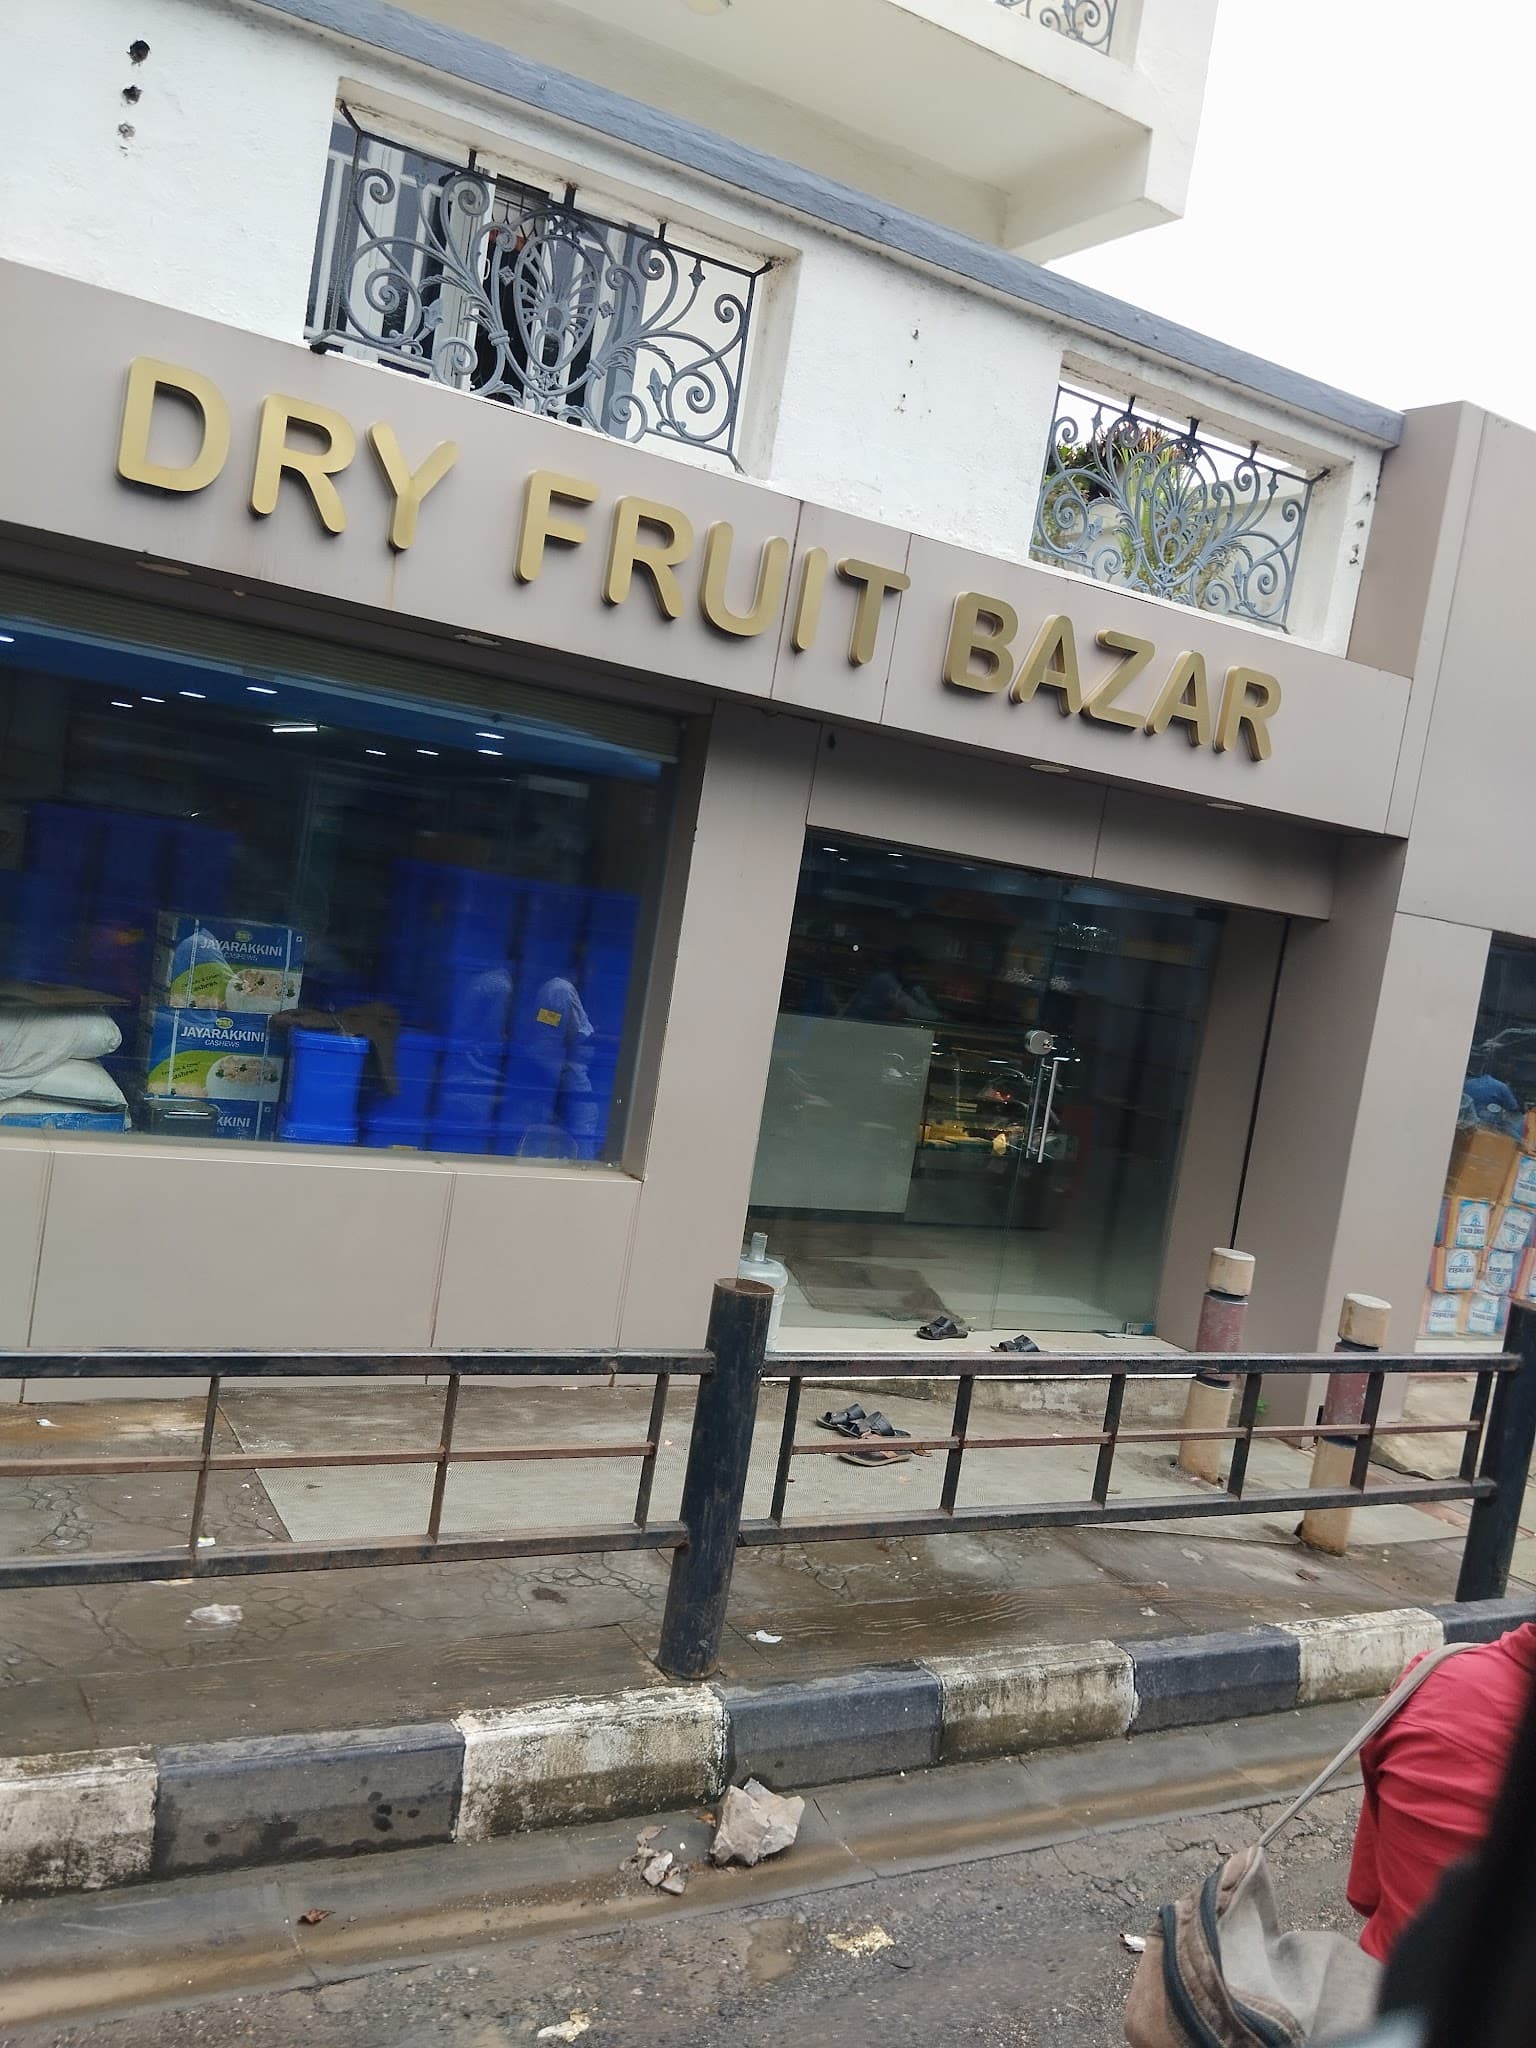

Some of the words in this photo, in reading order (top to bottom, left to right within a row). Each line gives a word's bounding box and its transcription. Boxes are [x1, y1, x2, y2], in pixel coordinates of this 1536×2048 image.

[116, 355, 460, 552] DRY
[514, 469, 911, 668] FRUIT
[943, 591, 1282, 762] BAZAR
[199, 937, 283, 957] JAYARAKKINI
[180, 1026, 265, 1043] JAYARAKKINI
[204, 1038, 240, 1048] CASHEWS
